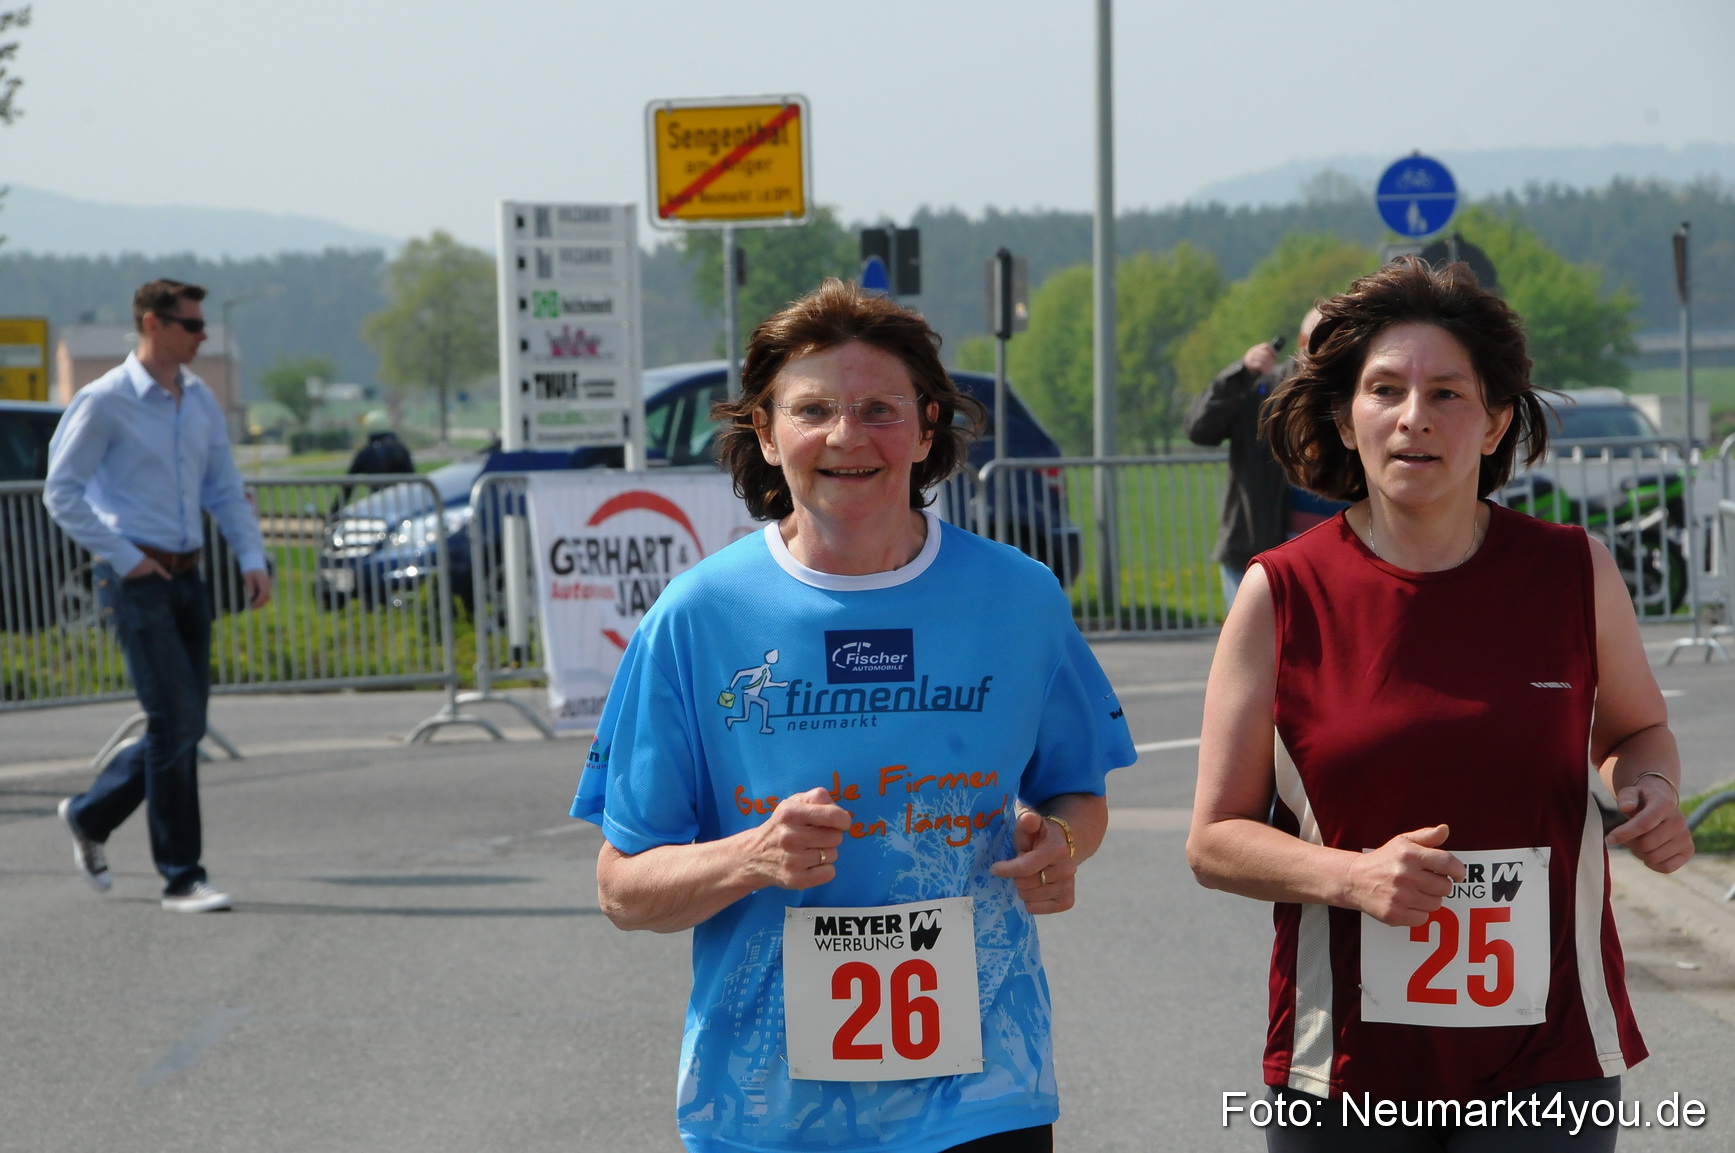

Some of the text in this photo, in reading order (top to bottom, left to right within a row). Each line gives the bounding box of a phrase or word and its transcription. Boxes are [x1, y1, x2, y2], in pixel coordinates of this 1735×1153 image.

[668, 117, 789, 156] Sengenthal
[550, 537, 673, 575] GERHART
[846, 651, 908, 666] Fischer
[852, 664, 904, 672] AUTOMOBILE
[785, 675, 994, 715] firmenlauf
[786, 714, 878, 731] neumarkt
[879, 764, 998, 796] Firmen
[905, 793, 1009, 847] länger!
[814, 913, 904, 936] MEYER
[814, 935, 905, 952] WERBUNG
[1406, 905, 1515, 1008] 25
[831, 958, 941, 1061] 26
